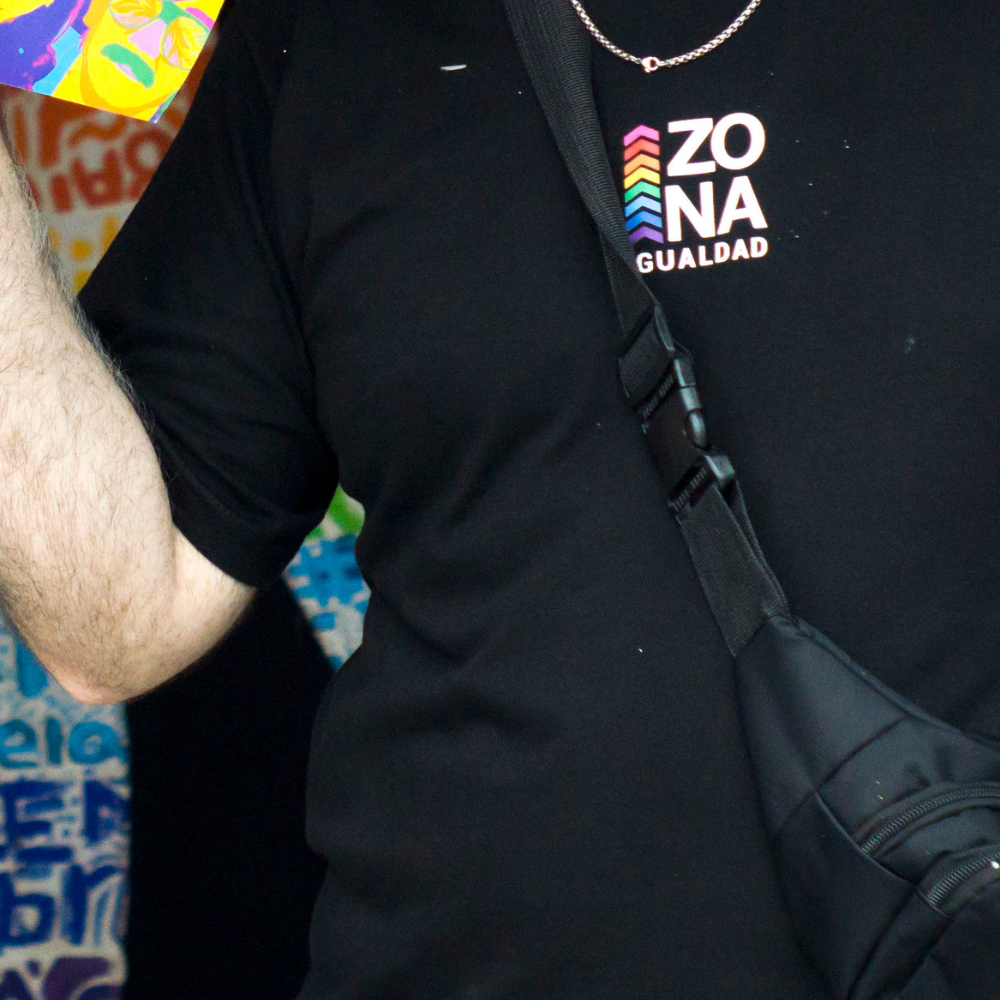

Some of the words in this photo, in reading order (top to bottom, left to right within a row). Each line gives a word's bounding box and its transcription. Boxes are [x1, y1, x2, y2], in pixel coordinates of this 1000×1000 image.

[667, 112, 766, 177] ZO
[664, 175, 769, 242] NA
[636, 236, 769, 273] GUALDAD
